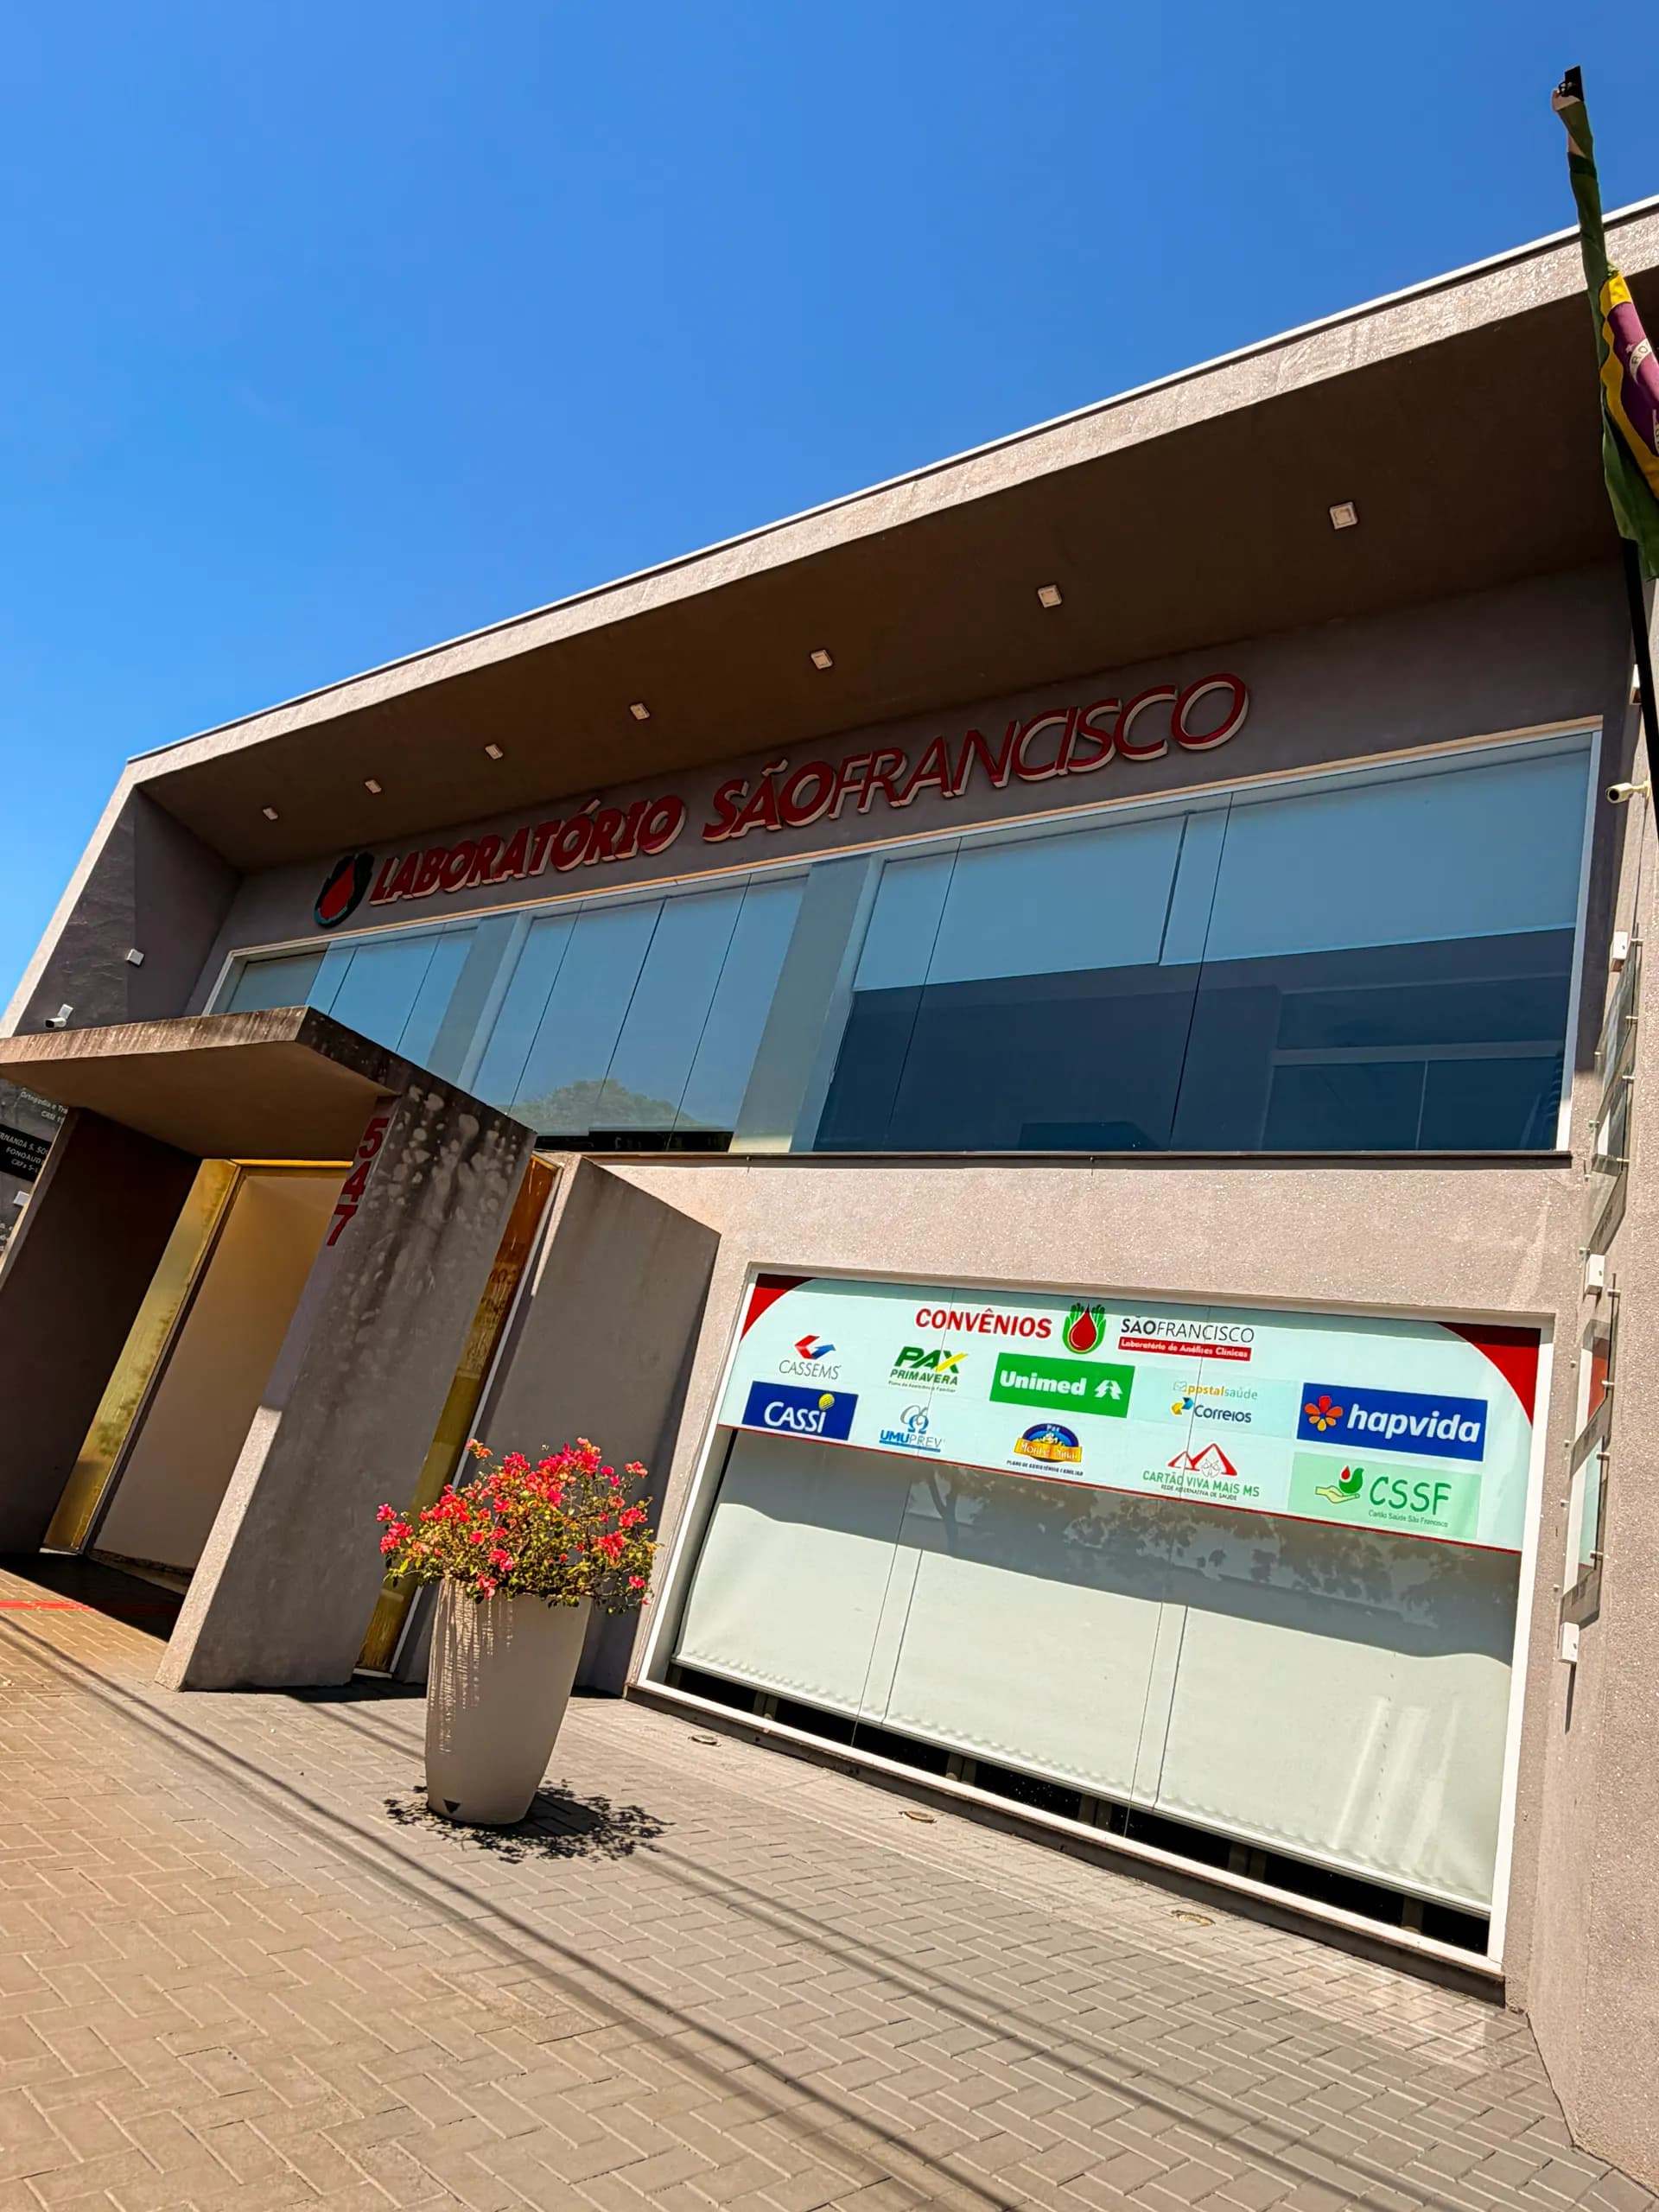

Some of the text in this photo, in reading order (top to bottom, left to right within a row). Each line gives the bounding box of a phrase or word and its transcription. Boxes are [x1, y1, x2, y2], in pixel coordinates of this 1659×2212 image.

[369, 796, 686, 906] LABORATÓRIO
[326, 1117, 390, 1246] 547
[914, 1307, 1052, 1338] CONVÊNIOS
[893, 1345, 968, 1374] PAX
[1121, 1338, 1166, 1351] Laboratório
[1167, 1343, 1179, 1351] de
[1215, 1347, 1249, 1358] Clínicas
[779, 1359, 840, 1380] CASSEMS
[889, 1369, 958, 1386] PRIMAVERA
[999, 1370, 1086, 1396] Unimed
[764, 1401, 827, 1433] CASSI
[1193, 1404, 1252, 1423] Correios
[1346, 1403, 1483, 1444] hapvida
[880, 1430, 943, 1448] UMUPREV
[1142, 1470, 1261, 1497] CARTÃO VIVA MAIS MS
[1370, 1476, 1452, 1516] CSSF
